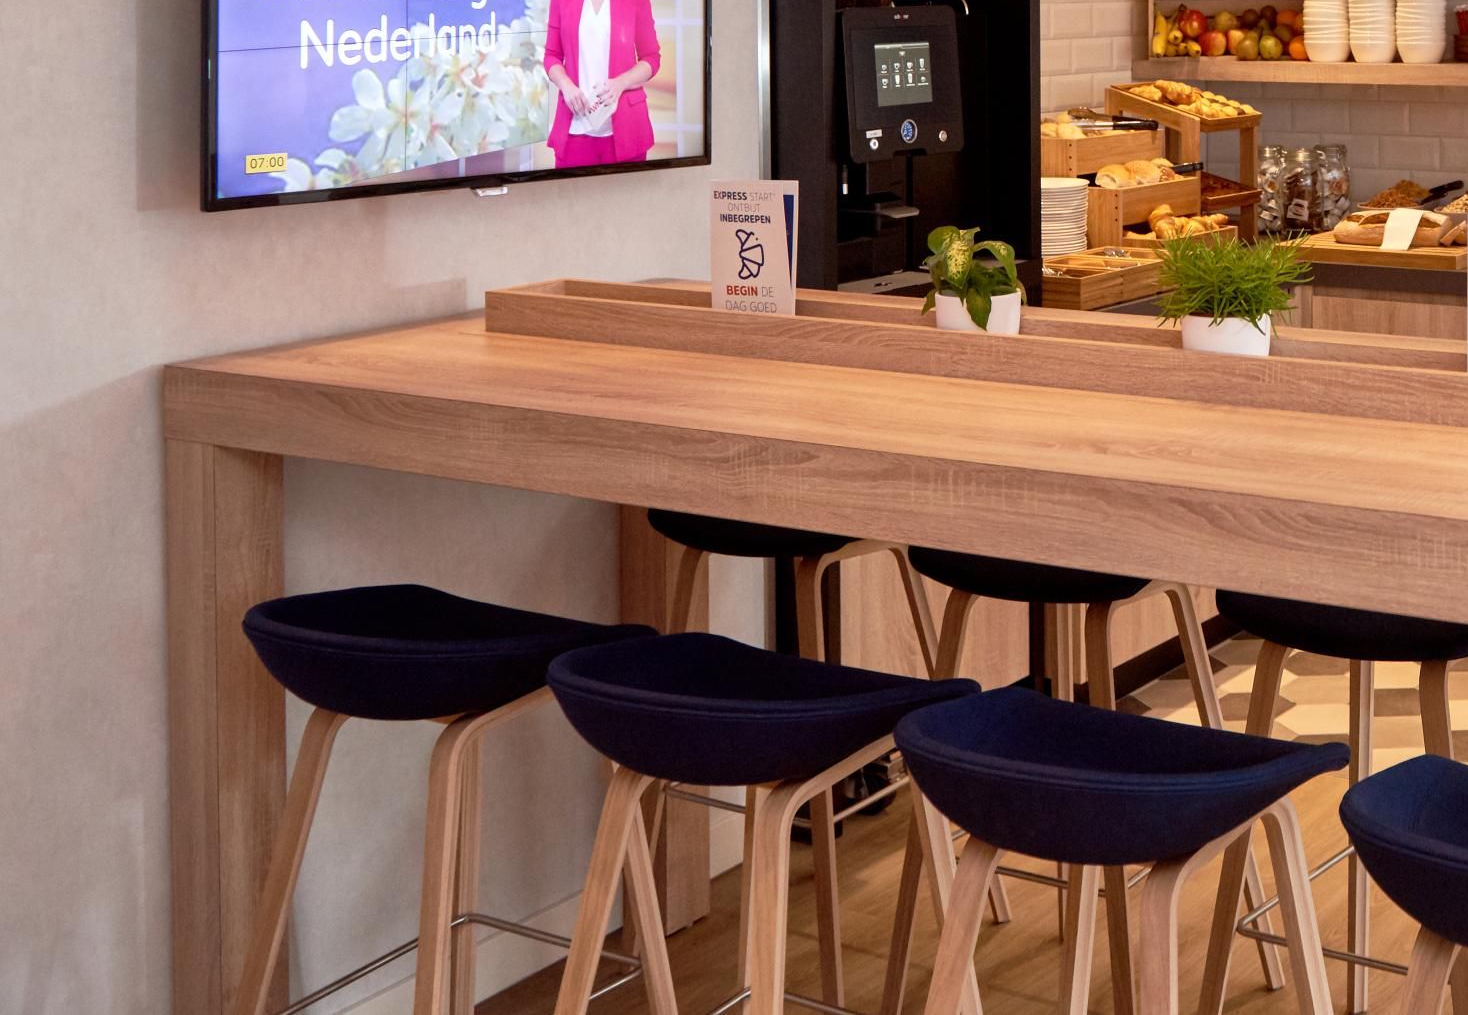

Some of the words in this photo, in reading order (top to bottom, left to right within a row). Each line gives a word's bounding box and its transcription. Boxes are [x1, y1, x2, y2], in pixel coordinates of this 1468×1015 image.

[299, 11, 497, 70] Nederland
[249, 156, 285, 171] 07:00
[713, 190, 748, 201] EXPRESS
[727, 202, 760, 212] ONTBIJT
[720, 214, 771, 224] INBEGREPEN
[727, 285, 758, 296] BEGIN
[761, 287, 775, 298] DE
[725, 300, 747, 312] DAG
[750, 301, 777, 314] GOED
